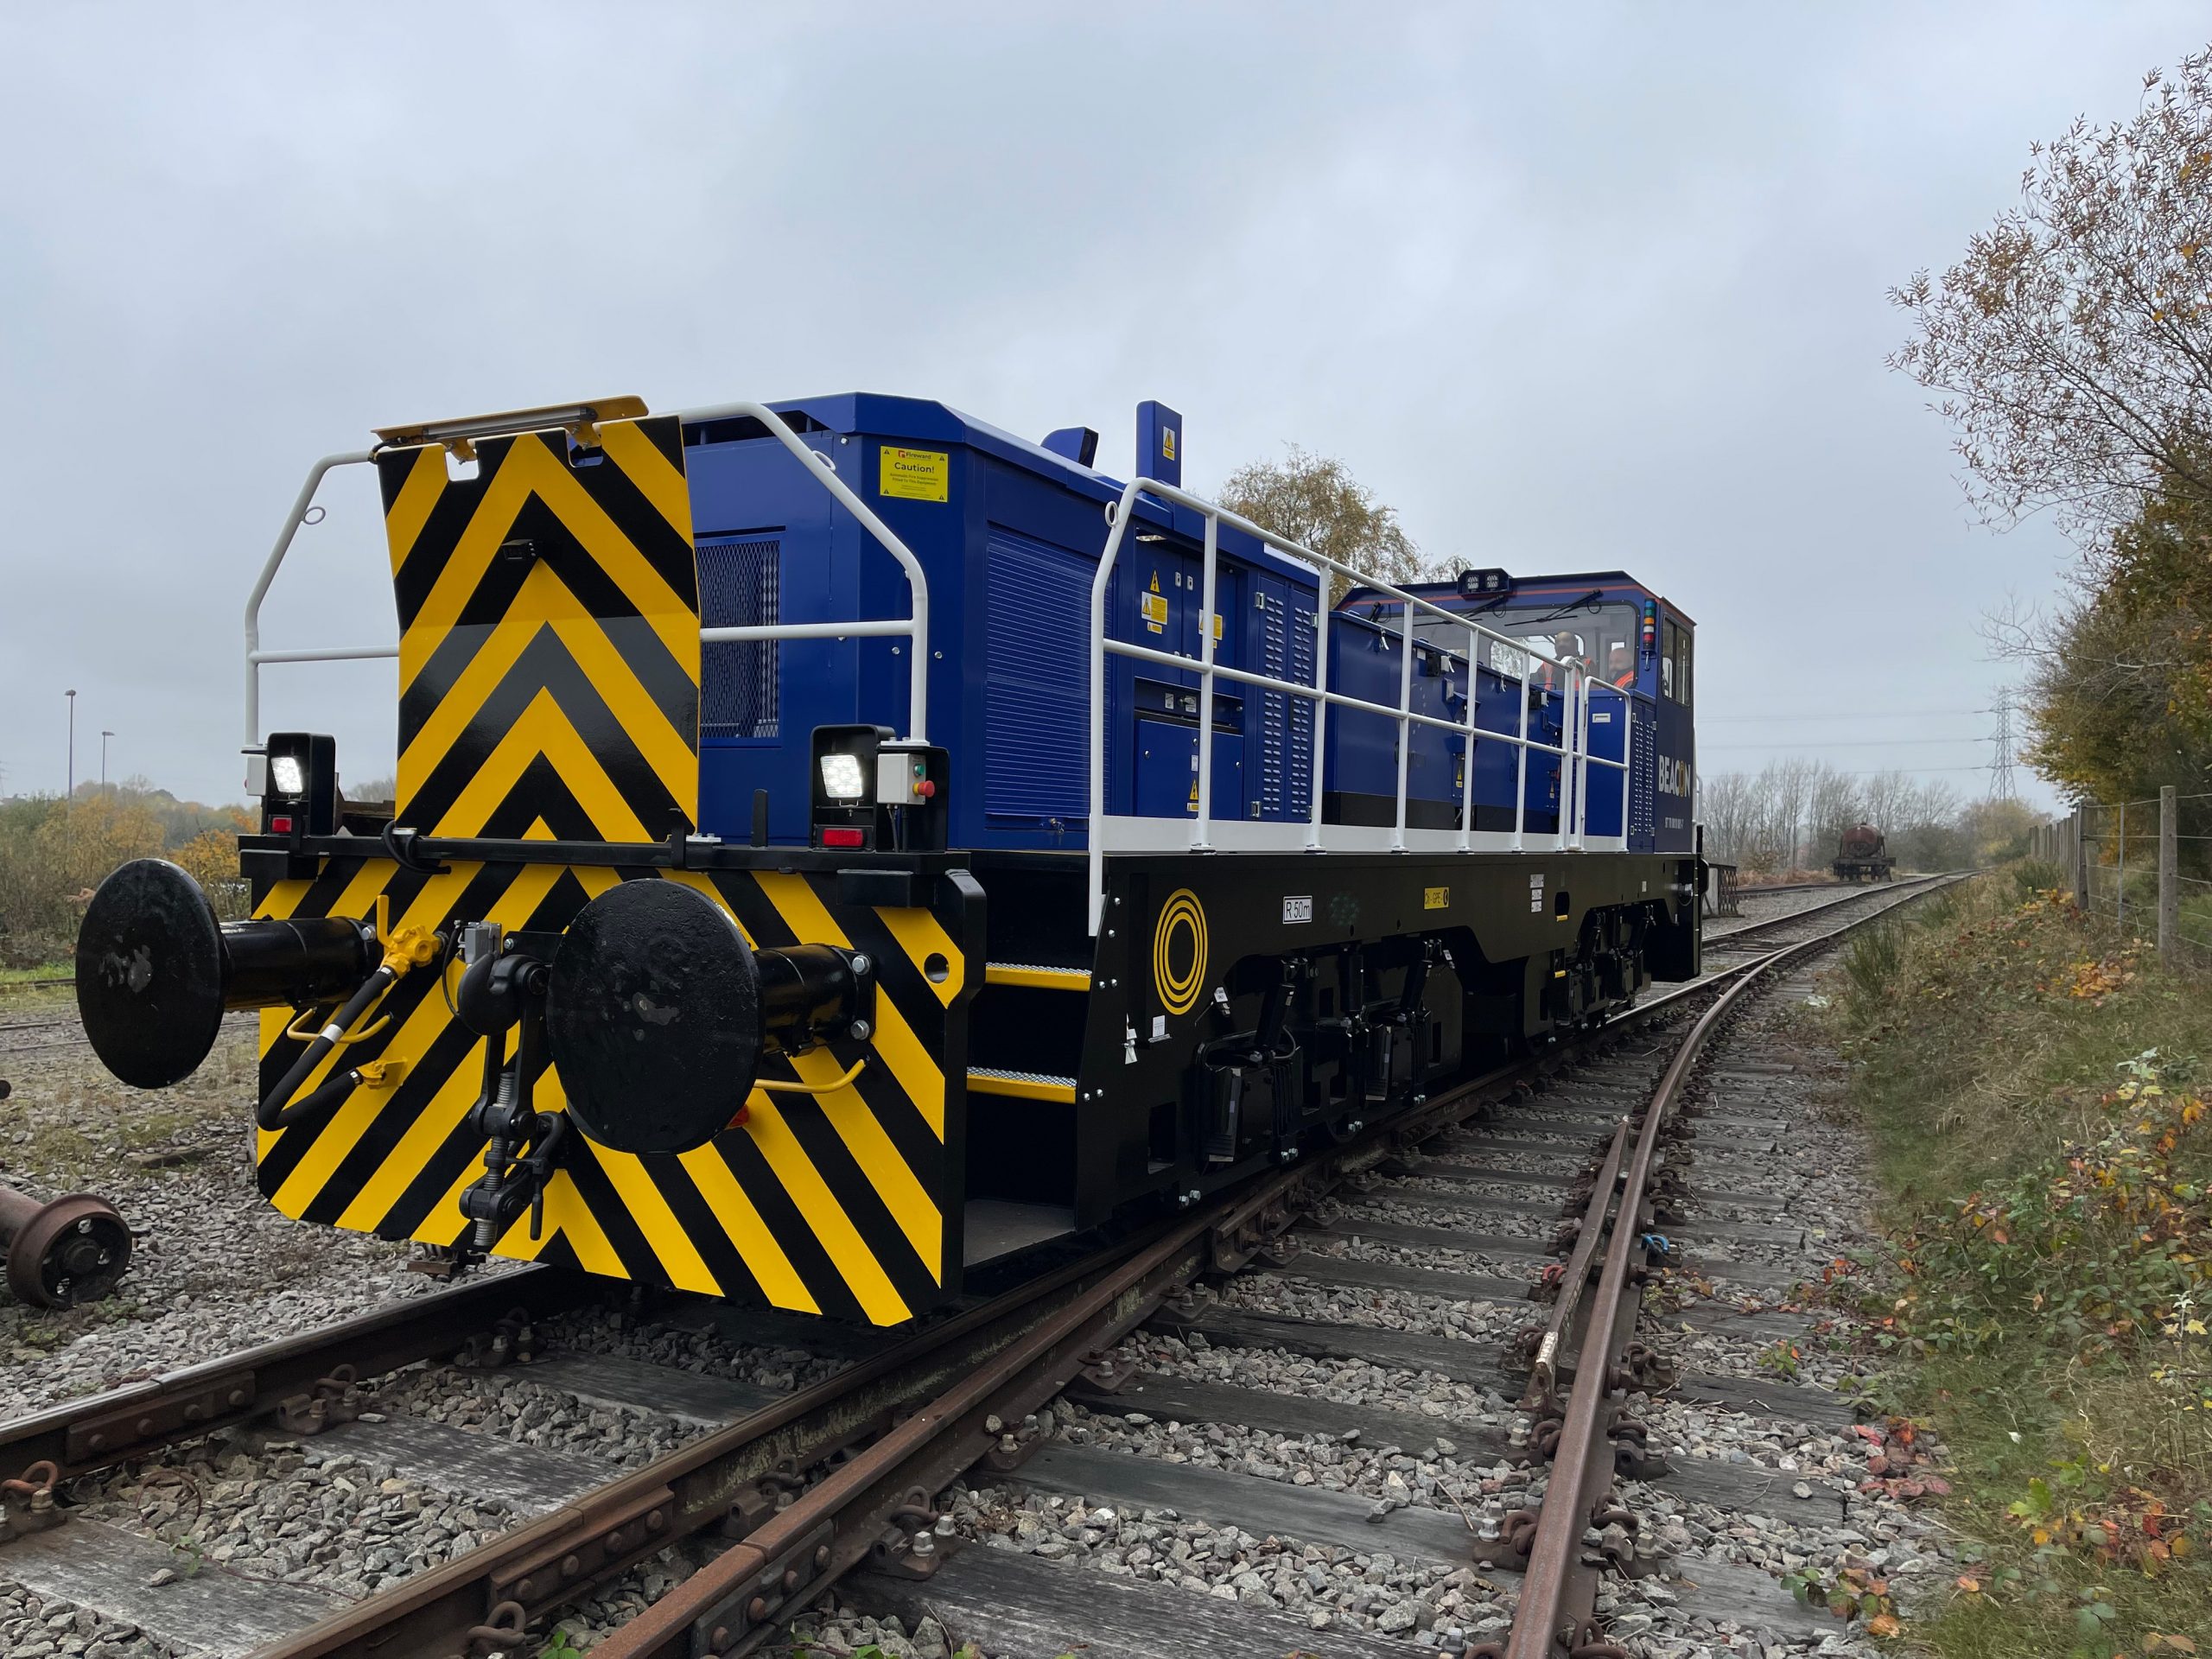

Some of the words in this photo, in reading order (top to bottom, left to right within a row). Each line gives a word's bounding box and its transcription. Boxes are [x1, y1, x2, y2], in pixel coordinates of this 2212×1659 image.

[894, 462, 934, 474] Caution!
[1658, 754, 1690, 798] BEACON
[1286, 901, 1292, 918] R
[1294, 900, 1310, 918] 50m
